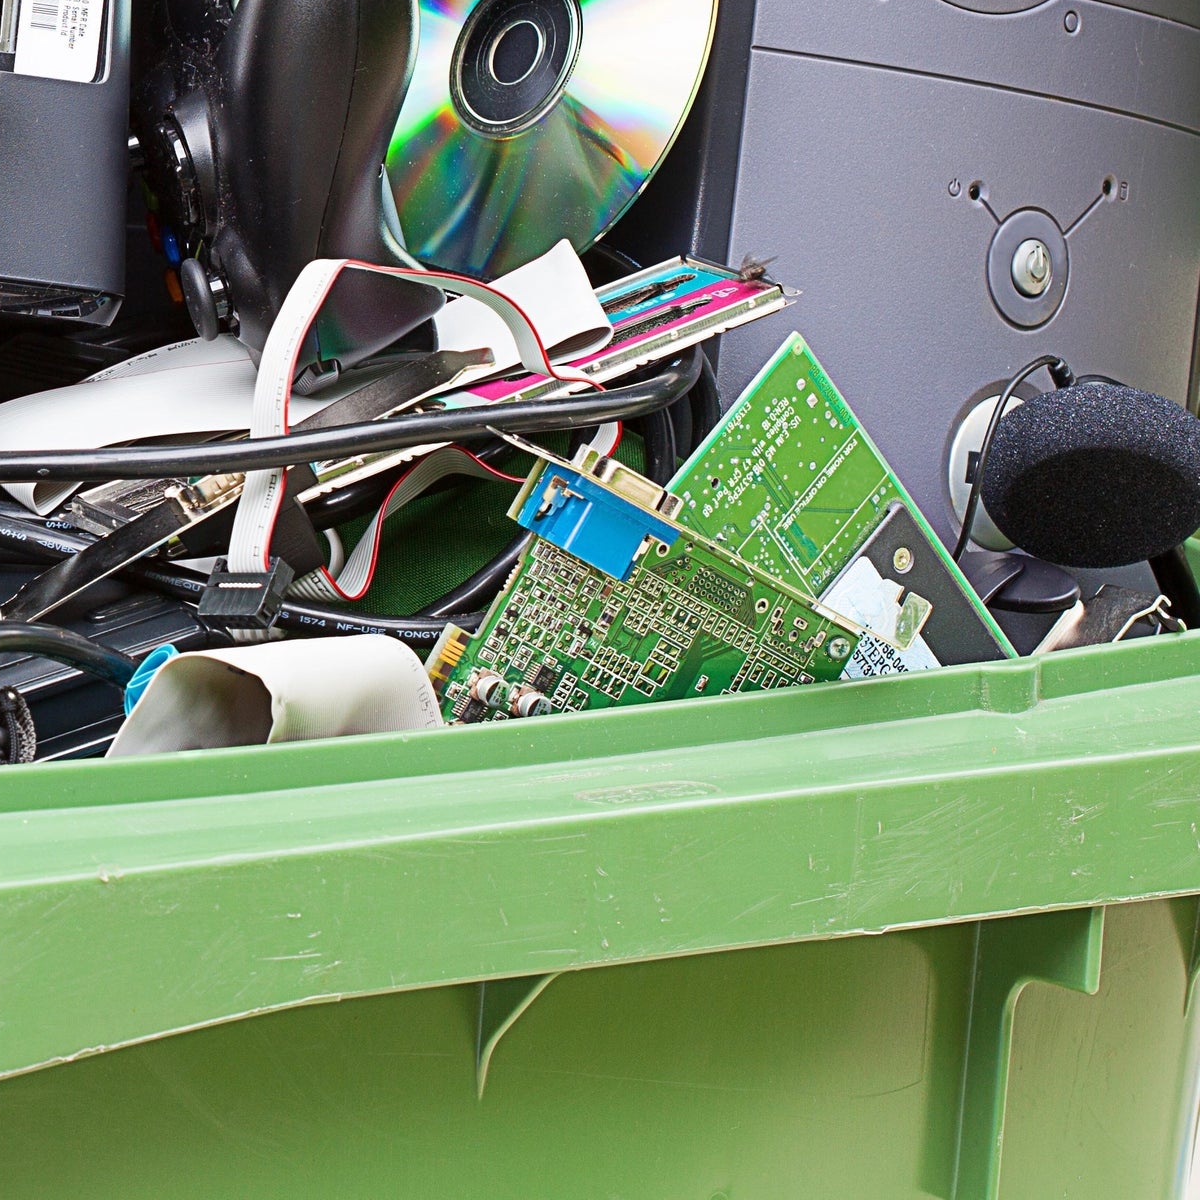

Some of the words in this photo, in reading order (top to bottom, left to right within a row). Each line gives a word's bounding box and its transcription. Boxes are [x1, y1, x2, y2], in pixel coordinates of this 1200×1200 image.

[764, 405, 795, 439] Complies
[787, 415, 801, 429] US:
[774, 428, 789, 445] EJM
[749, 439, 766, 456] with
[841, 437, 857, 456] FOR
[739, 457, 750, 470] 47
[824, 453, 845, 478] HOME
[726, 468, 741, 486] CFR
[814, 475, 827, 489] OR
[710, 484, 729, 505] Part
[794, 486, 817, 514] OFFICE
[781, 512, 796, 530] USE
[299, 615, 326, 627] 1574
[336, 622, 386, 635] NF-USE
